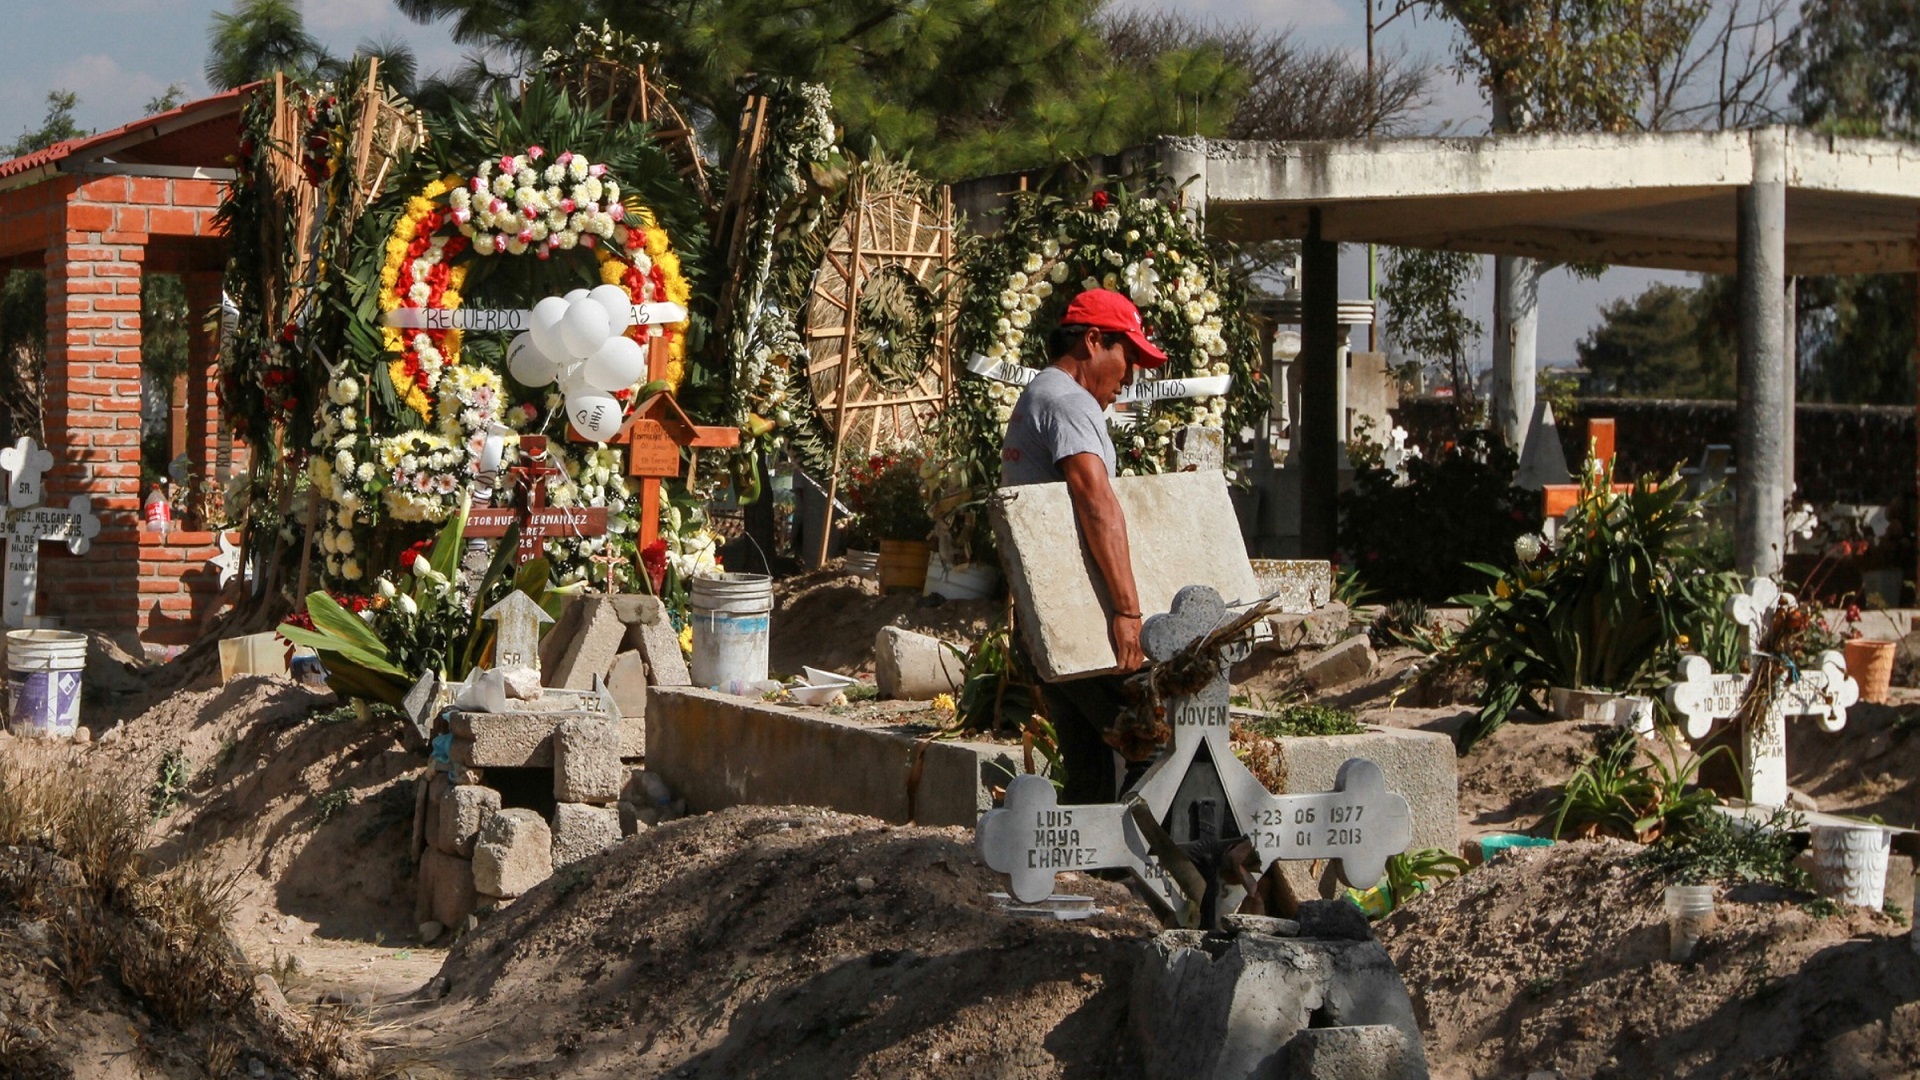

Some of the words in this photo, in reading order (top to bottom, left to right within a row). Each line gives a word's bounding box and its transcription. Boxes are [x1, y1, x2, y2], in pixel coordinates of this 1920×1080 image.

[422, 304, 521, 331] RECUERDO
[1135, 380, 1186, 399] AMIGOS
[19, 482, 33, 494] SR.
[12, 544, 34, 553] HIJAS
[20, 554, 25, 562] Y
[1178, 705, 1226, 726] JOVEN
[1037, 811, 1073, 828] LUIS
[1263, 809, 1282, 826] 23
[1295, 808, 1315, 824] 06
[1330, 806, 1364, 823] 1977
[1034, 829, 1080, 848] MAYA
[1264, 832, 1281, 848] 21
[1296, 831, 1312, 846] 01
[1327, 828, 1362, 845] 2013
[1028, 848, 1098, 869] CHAVEZ
